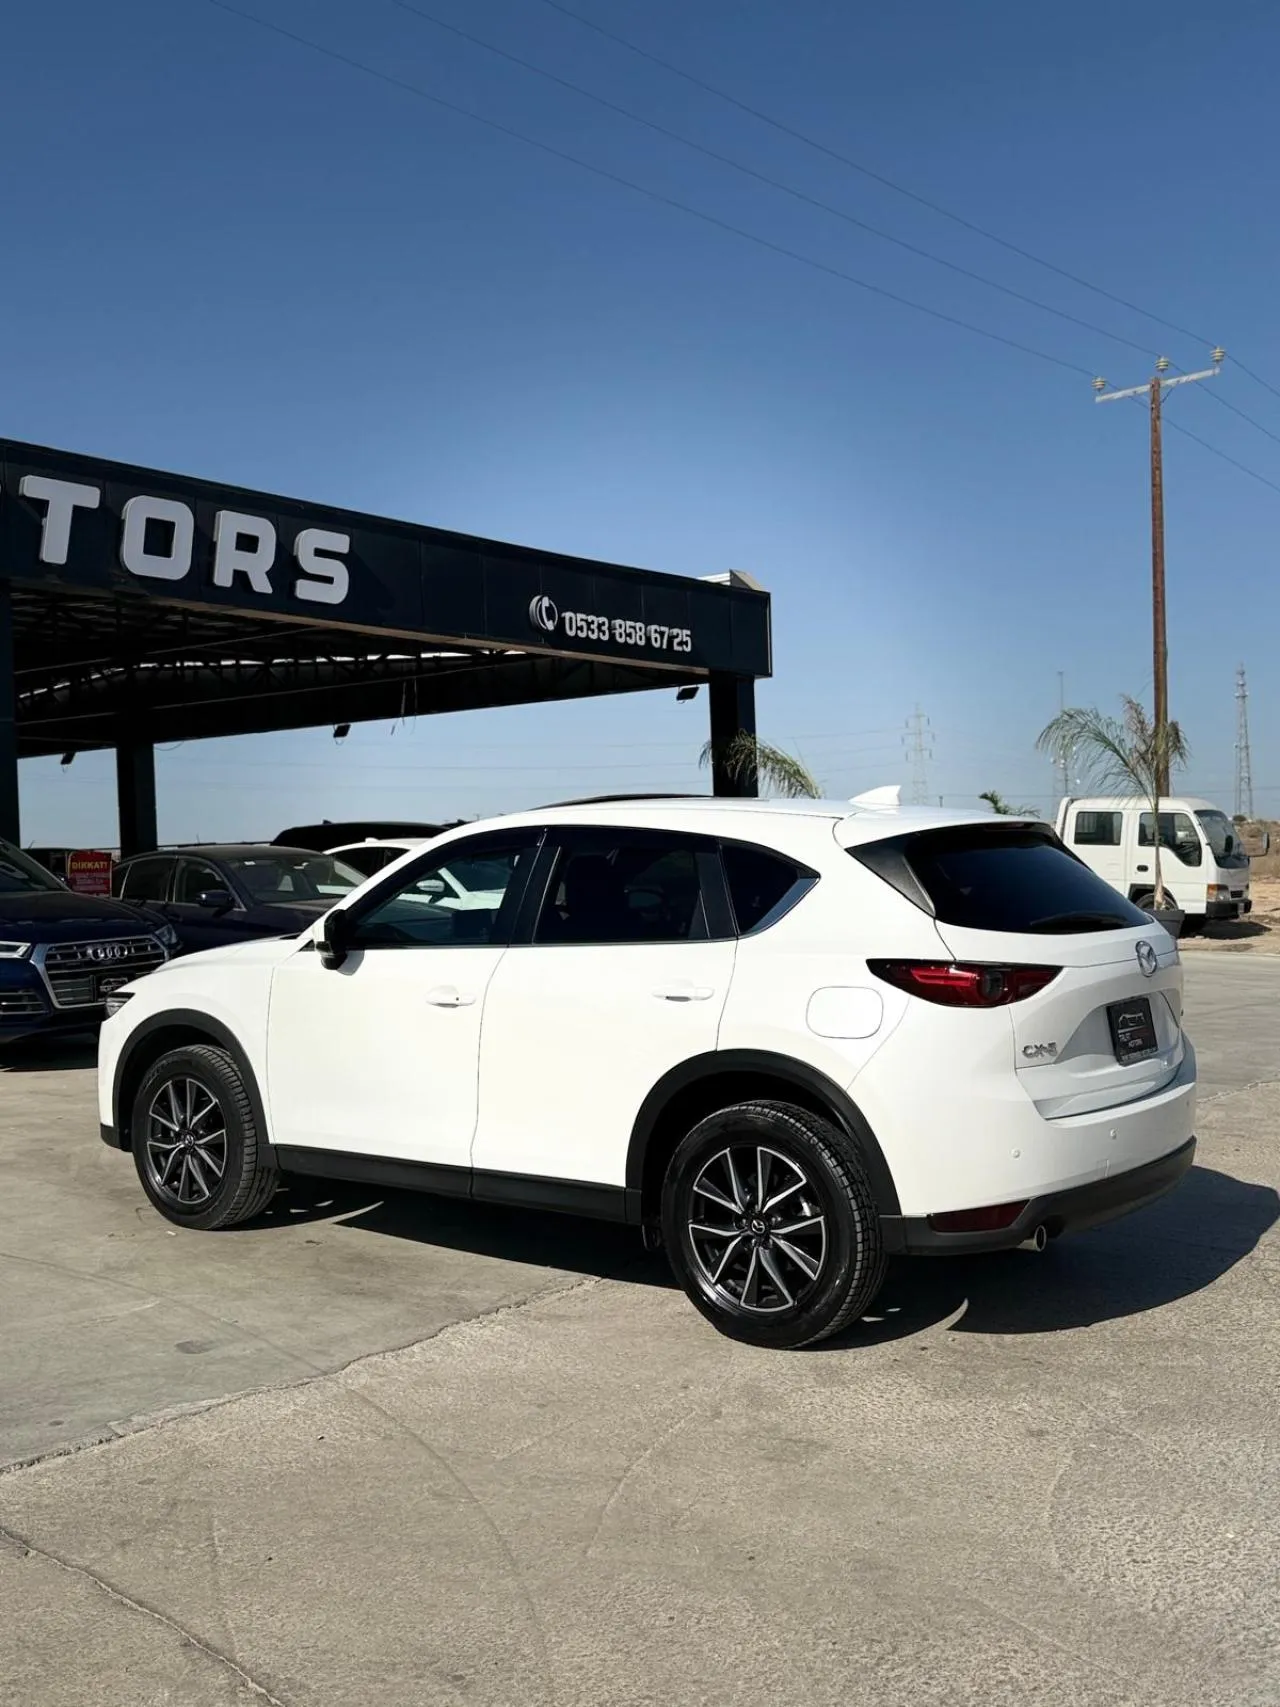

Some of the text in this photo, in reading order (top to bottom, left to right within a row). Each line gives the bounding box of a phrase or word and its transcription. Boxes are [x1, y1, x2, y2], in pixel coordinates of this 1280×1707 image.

[0, 475, 350, 605] TORS
[563, 611, 609, 641] 0533
[613, 619, 646, 646] 858
[1022, 1042, 1058, 1059] CX-5
